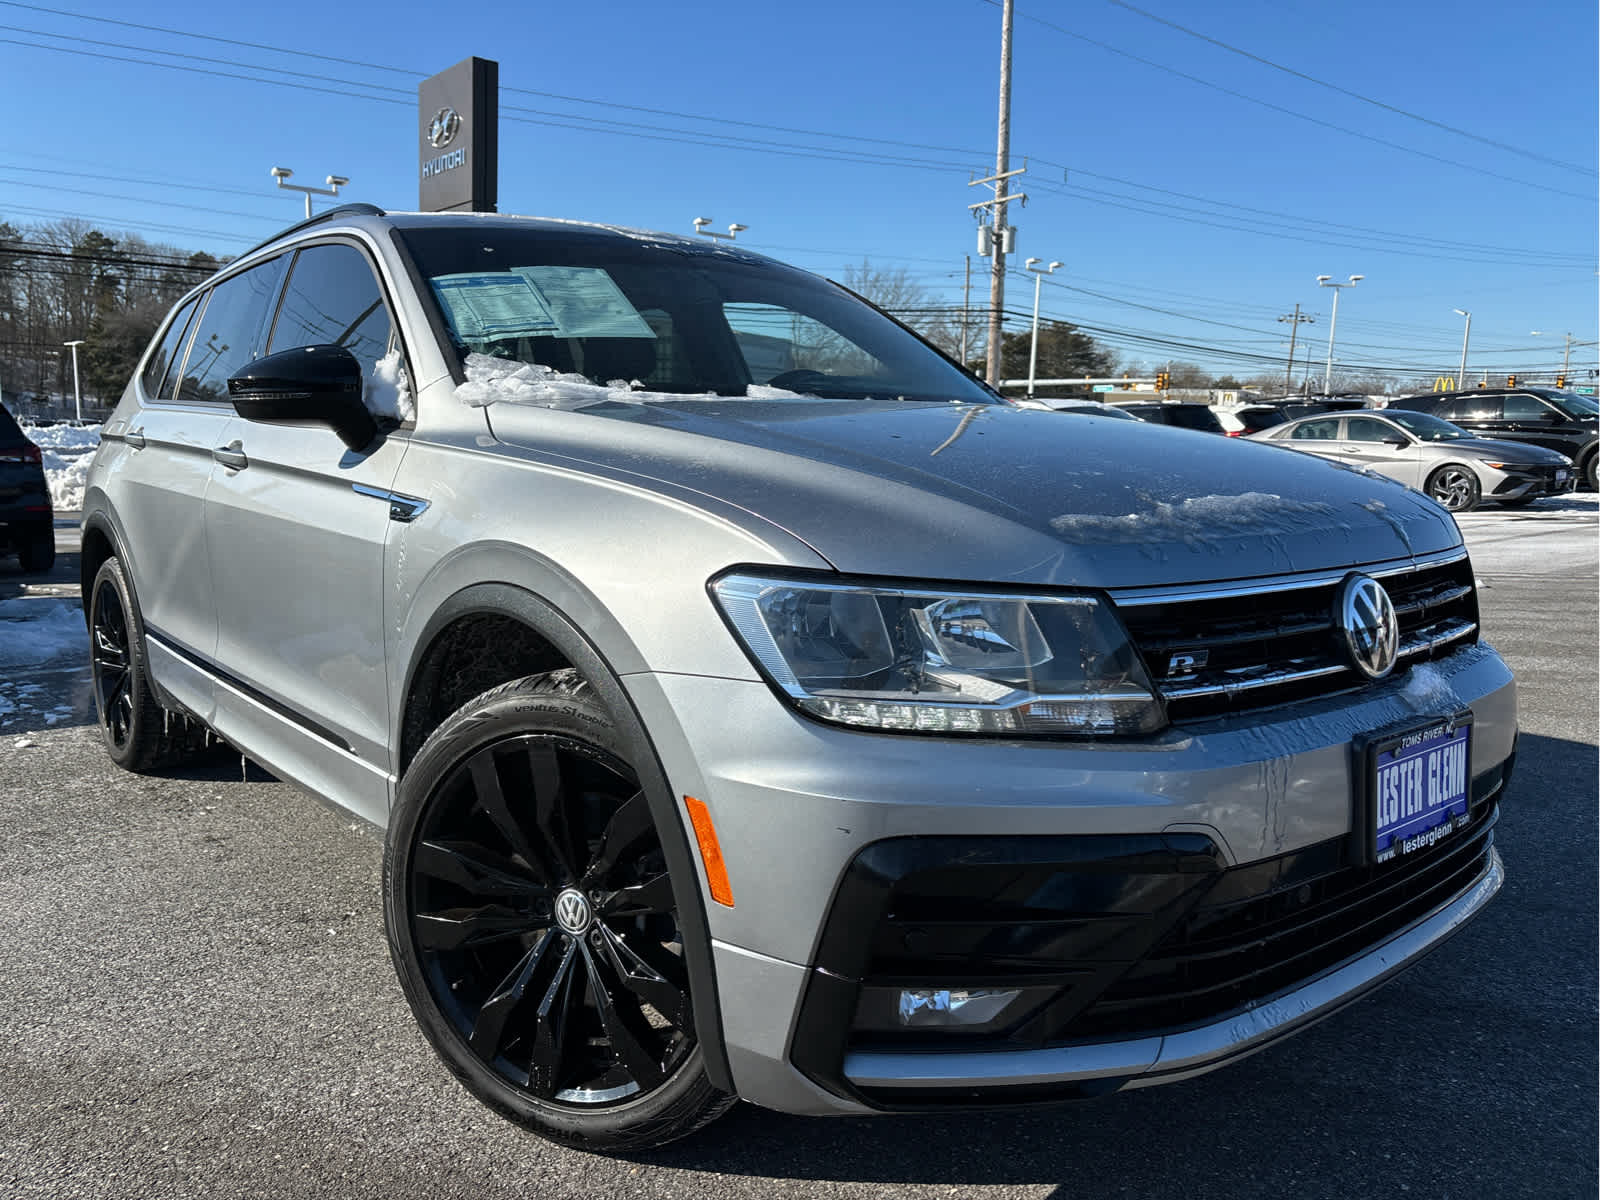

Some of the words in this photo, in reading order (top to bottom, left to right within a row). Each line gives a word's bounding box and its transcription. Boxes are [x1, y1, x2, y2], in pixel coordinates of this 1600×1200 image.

[423, 148, 465, 177] HYUNDAI
[1401, 733, 1422, 749] TOMS
[1376, 757, 1423, 830] LESTER
[1428, 740, 1466, 808] GLENN
